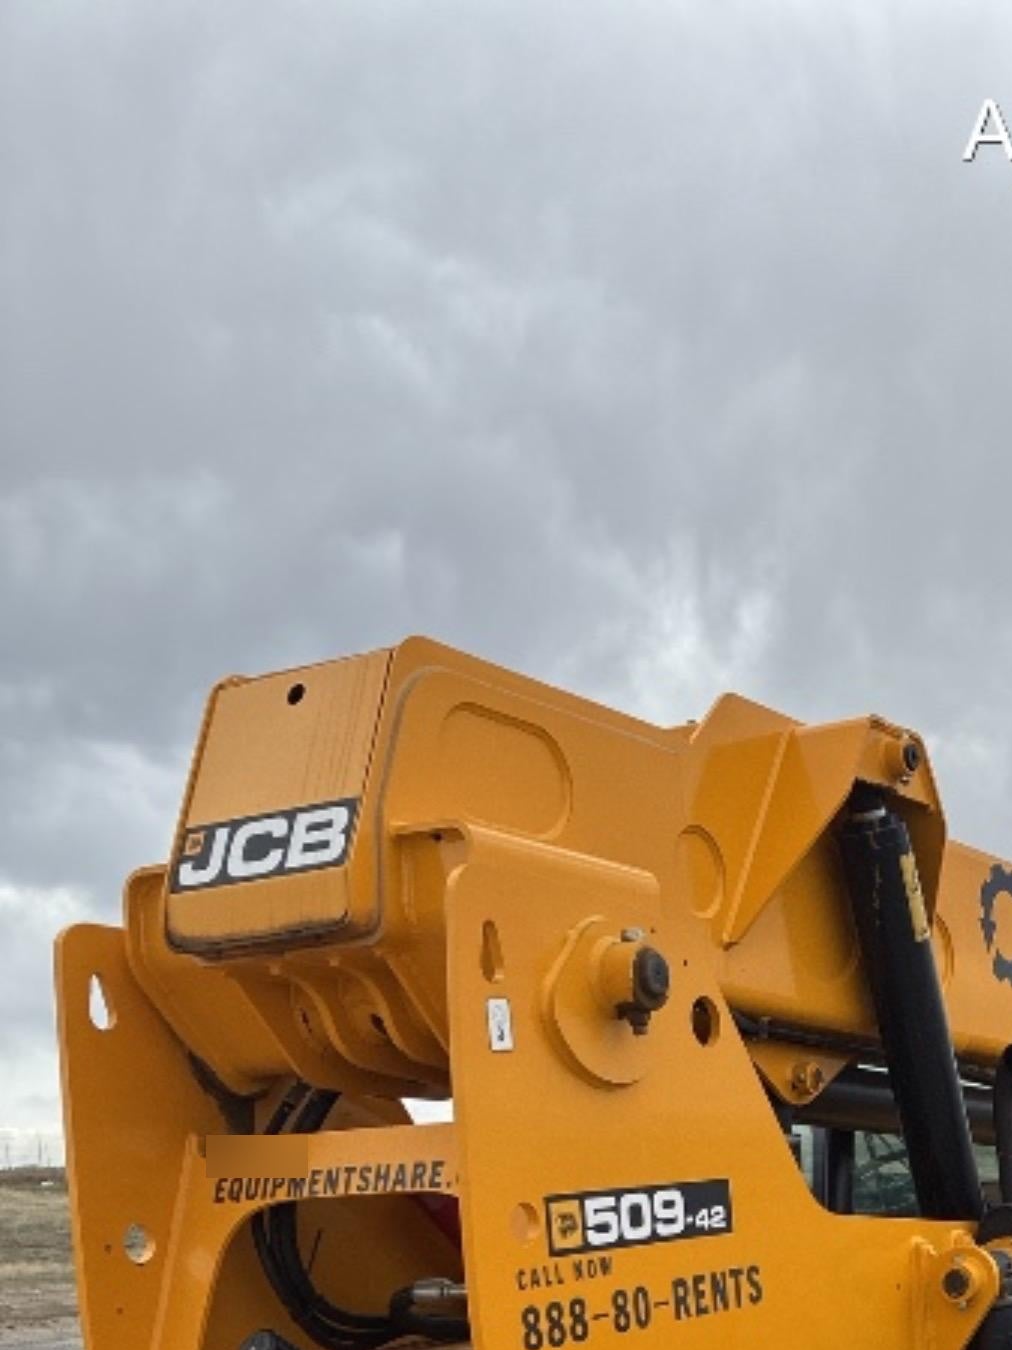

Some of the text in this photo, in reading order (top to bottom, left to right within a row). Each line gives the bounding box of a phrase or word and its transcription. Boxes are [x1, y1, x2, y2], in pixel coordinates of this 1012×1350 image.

[178, 805, 350, 887] JCB
[516, 1256, 613, 1291] CALL NOW
